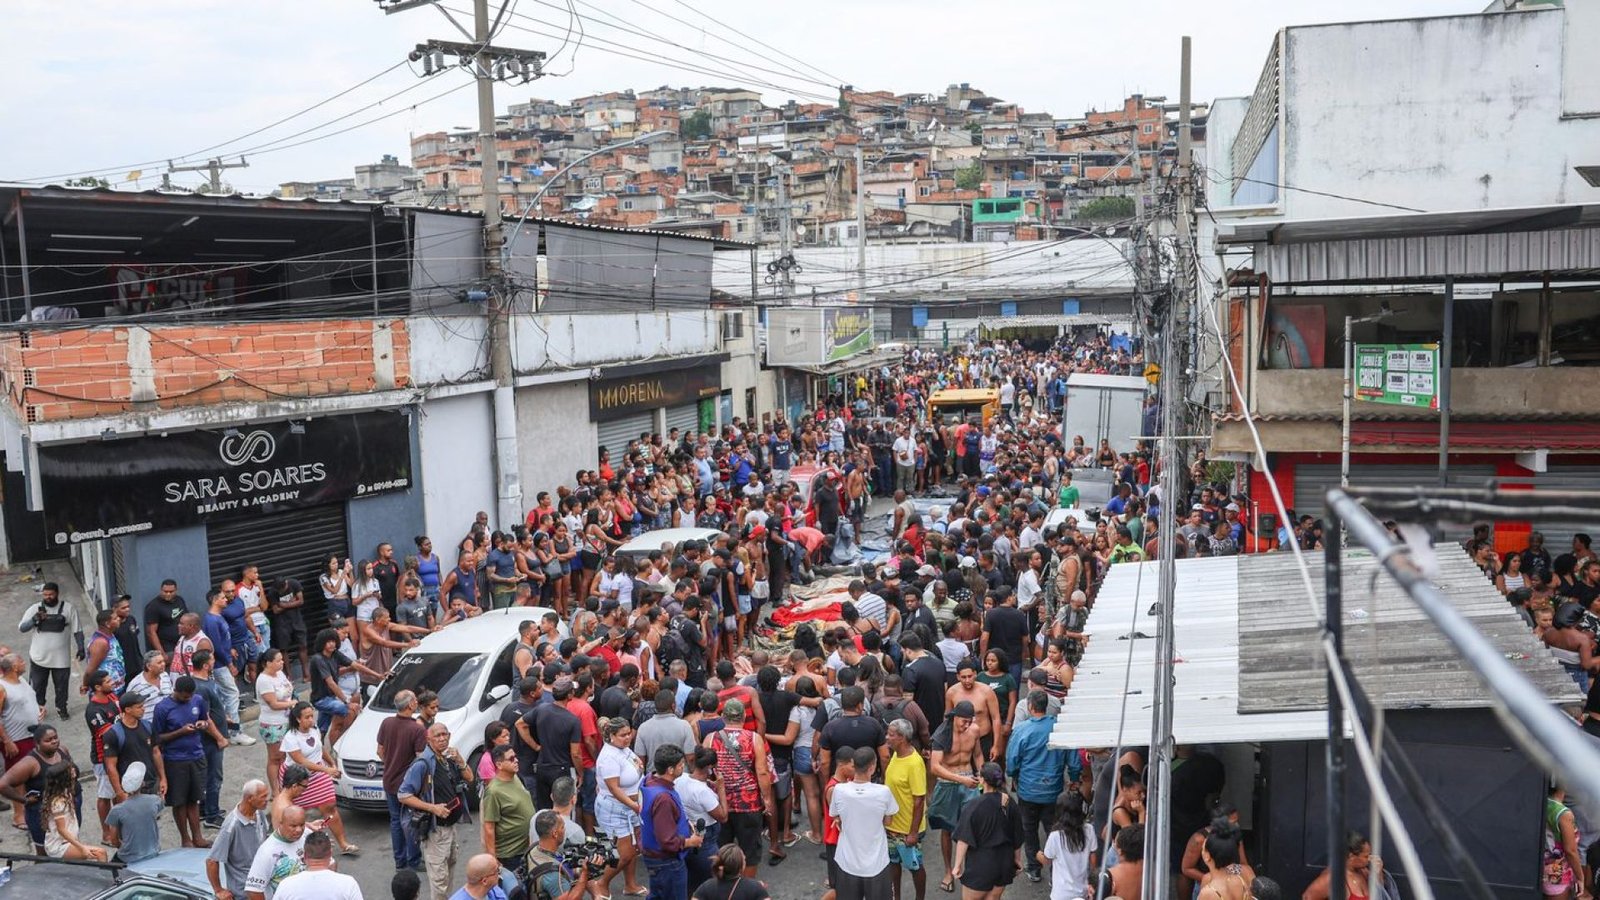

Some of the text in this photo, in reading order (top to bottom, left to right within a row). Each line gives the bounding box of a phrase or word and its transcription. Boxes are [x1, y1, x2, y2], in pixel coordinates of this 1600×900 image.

[165, 463, 327, 503] SARA SOARES
[197, 490, 300, 514] BEAUTY & ACADEMY
